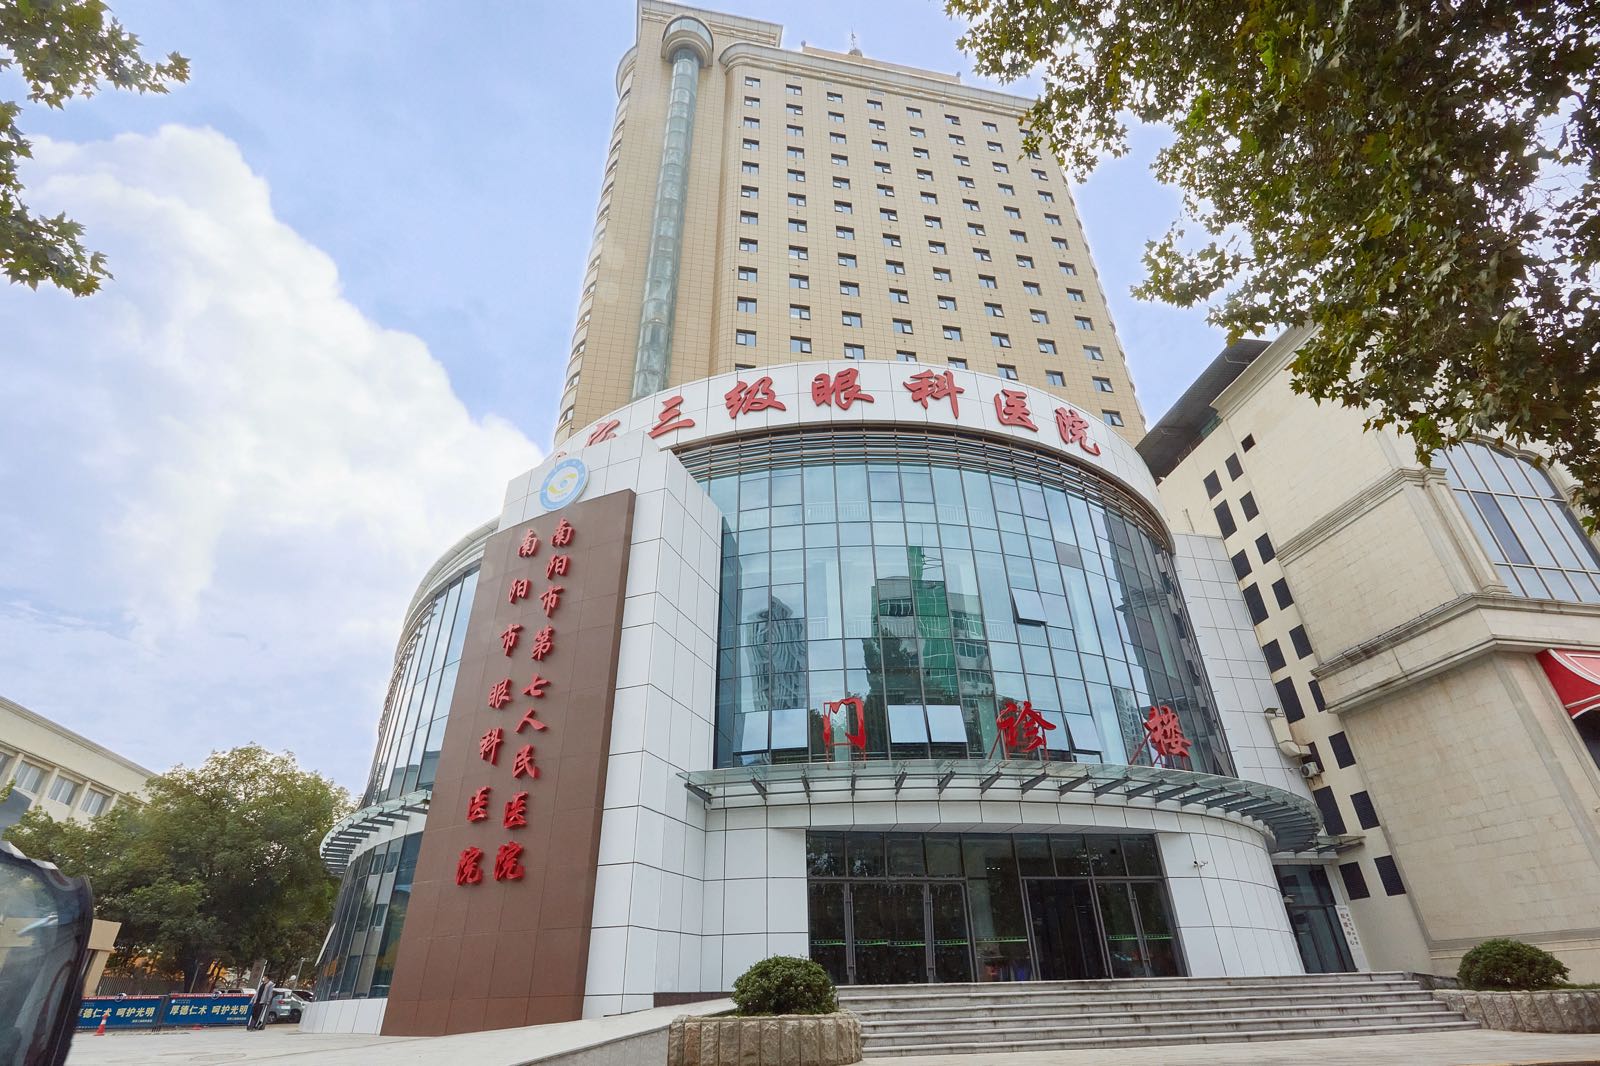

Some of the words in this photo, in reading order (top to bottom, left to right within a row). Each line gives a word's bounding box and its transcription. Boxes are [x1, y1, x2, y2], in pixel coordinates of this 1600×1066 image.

[553, 367, 1101, 458] 三级眼科医院
[455, 528, 541, 887] 南阳市眼科医院
[493, 517, 576, 881] 南阳市第七人民医院
[822, 697, 1192, 757] 门诊楼
[116, 1006, 156, 1018] 呵护光明
[169, 1004, 208, 1016] 厚德仁术
[211, 1004, 249, 1016] 呵护光明
